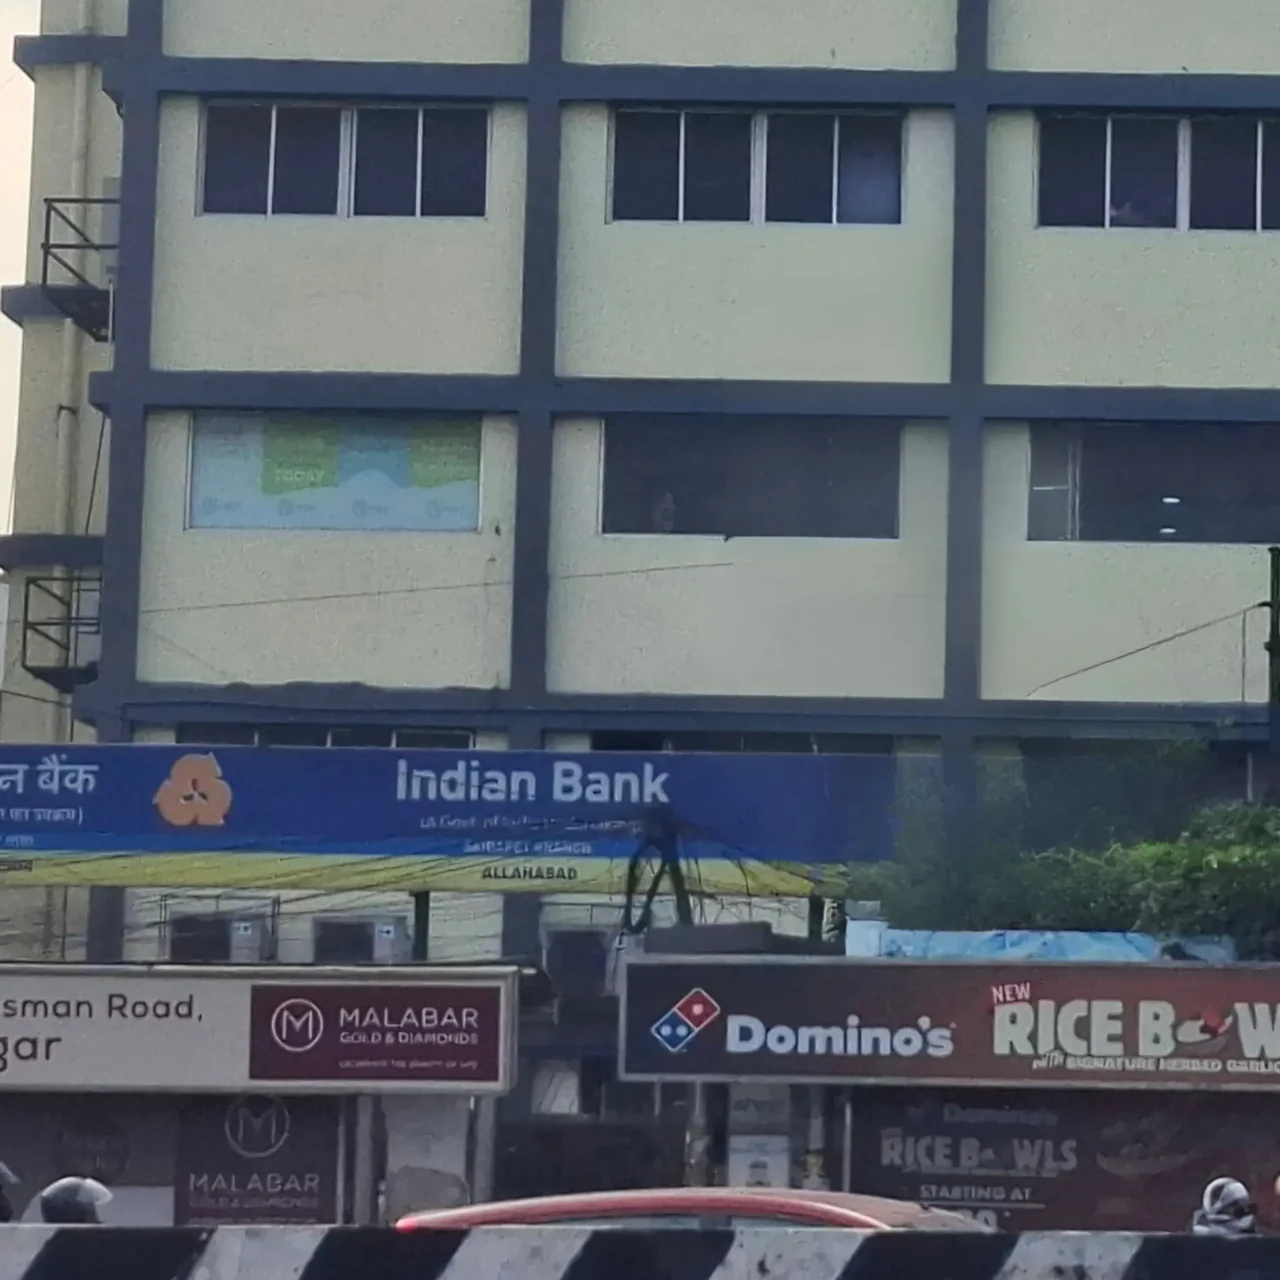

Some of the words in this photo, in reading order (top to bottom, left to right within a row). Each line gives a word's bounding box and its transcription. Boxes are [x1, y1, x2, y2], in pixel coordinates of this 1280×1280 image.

[36, 754, 100, 795] बैंक
[397, 759, 537, 802] Indian
[553, 762, 670, 803] Bank
[482, 865, 578, 881] ALLAHABAD
[992, 982, 1031, 1004] NEW
[3, 999, 93, 1019] sman
[107, 993, 203, 1023] Road,
[339, 1007, 480, 1029] MALABAR
[340, 1032, 382, 1044] GOLD
[726, 1014, 954, 1057] Domino's
[993, 999, 1124, 1057] RICE
[881, 1135, 952, 1167] RICE
[188, 1173, 320, 1193] MALABAR
[920, 1184, 1006, 1200] STARTING
[1010, 1187, 1032, 1200] AT
